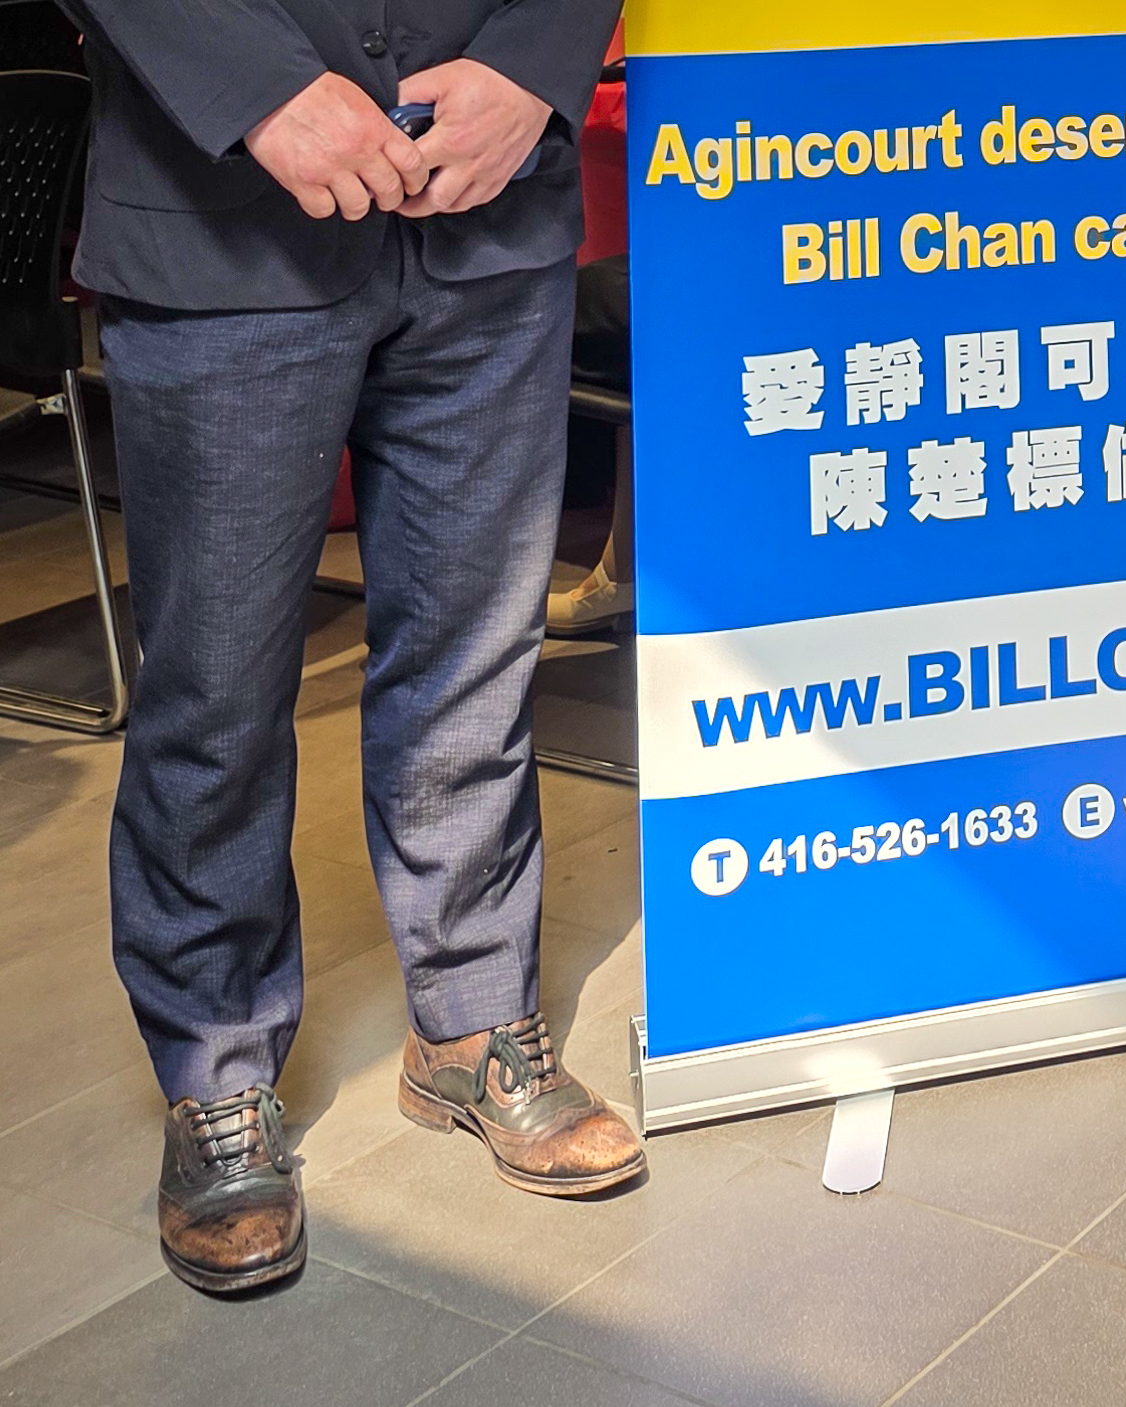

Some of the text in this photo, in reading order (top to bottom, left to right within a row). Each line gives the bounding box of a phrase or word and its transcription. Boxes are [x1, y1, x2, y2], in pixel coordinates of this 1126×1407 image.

[645, 108, 964, 200] Agincourt
[781, 216, 880, 285] Bill
[900, 209, 1057, 275] Chan
[707, 849, 732, 884] T
[758, 801, 1038, 877] 416-526-1633
[1078, 794, 1100, 828] E
